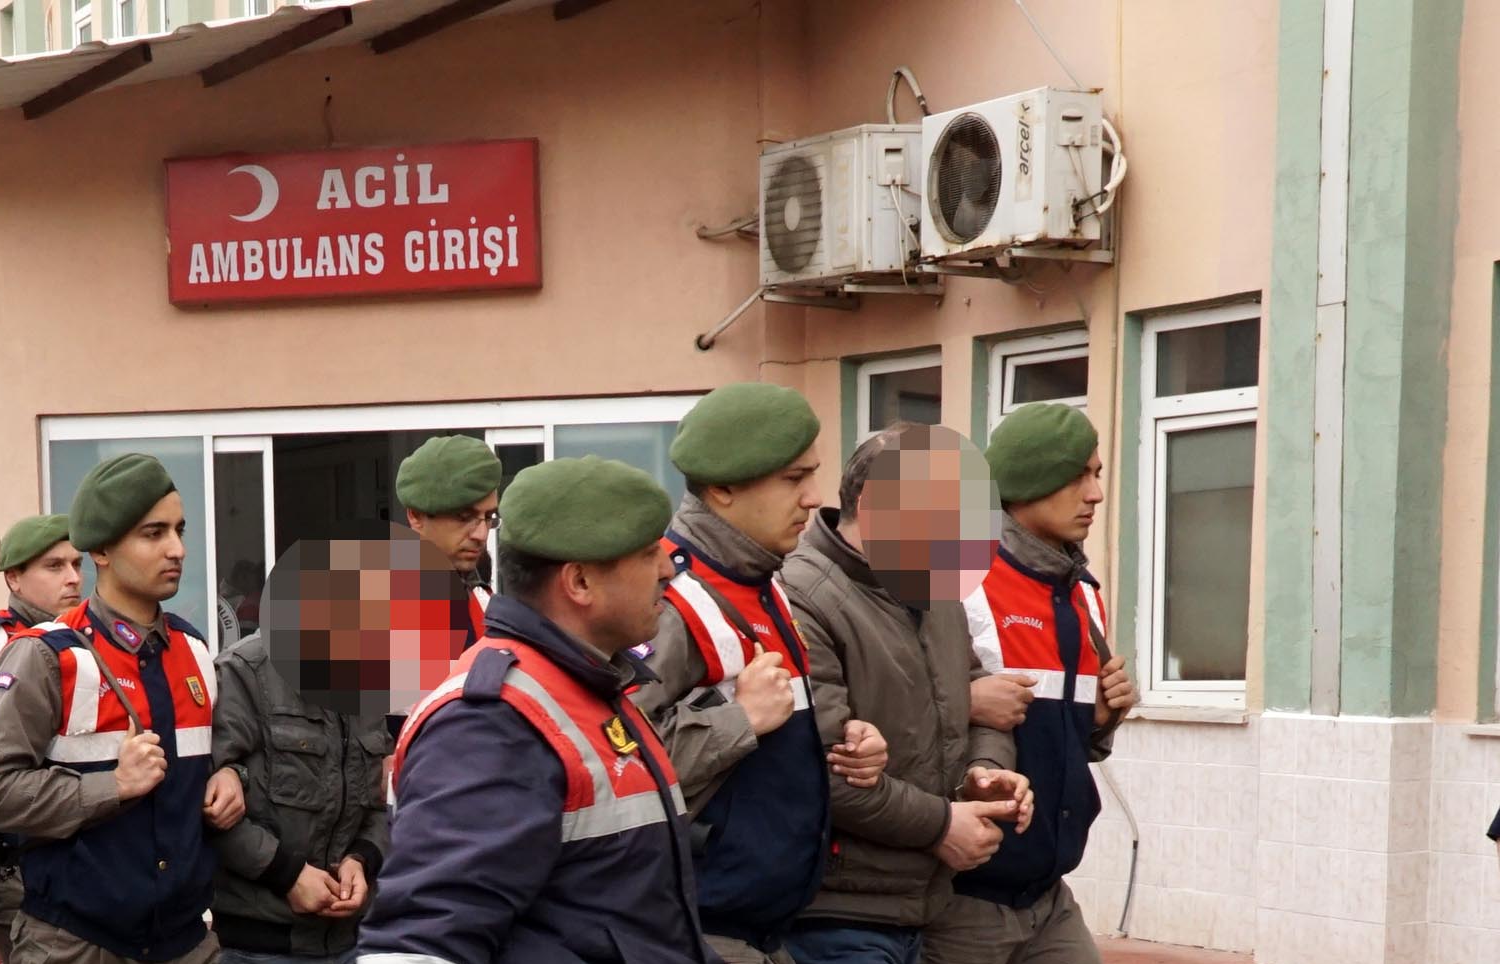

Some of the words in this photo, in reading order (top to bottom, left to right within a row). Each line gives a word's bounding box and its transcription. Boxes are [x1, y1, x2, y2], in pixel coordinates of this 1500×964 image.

[1018, 103, 1032, 175] arçelk
[316, 153, 449, 210] ACİL
[188, 233, 385, 284] AMBULANS
[404, 214, 519, 277] GİRİŞİ
[99, 677, 136, 698] JANRMA
